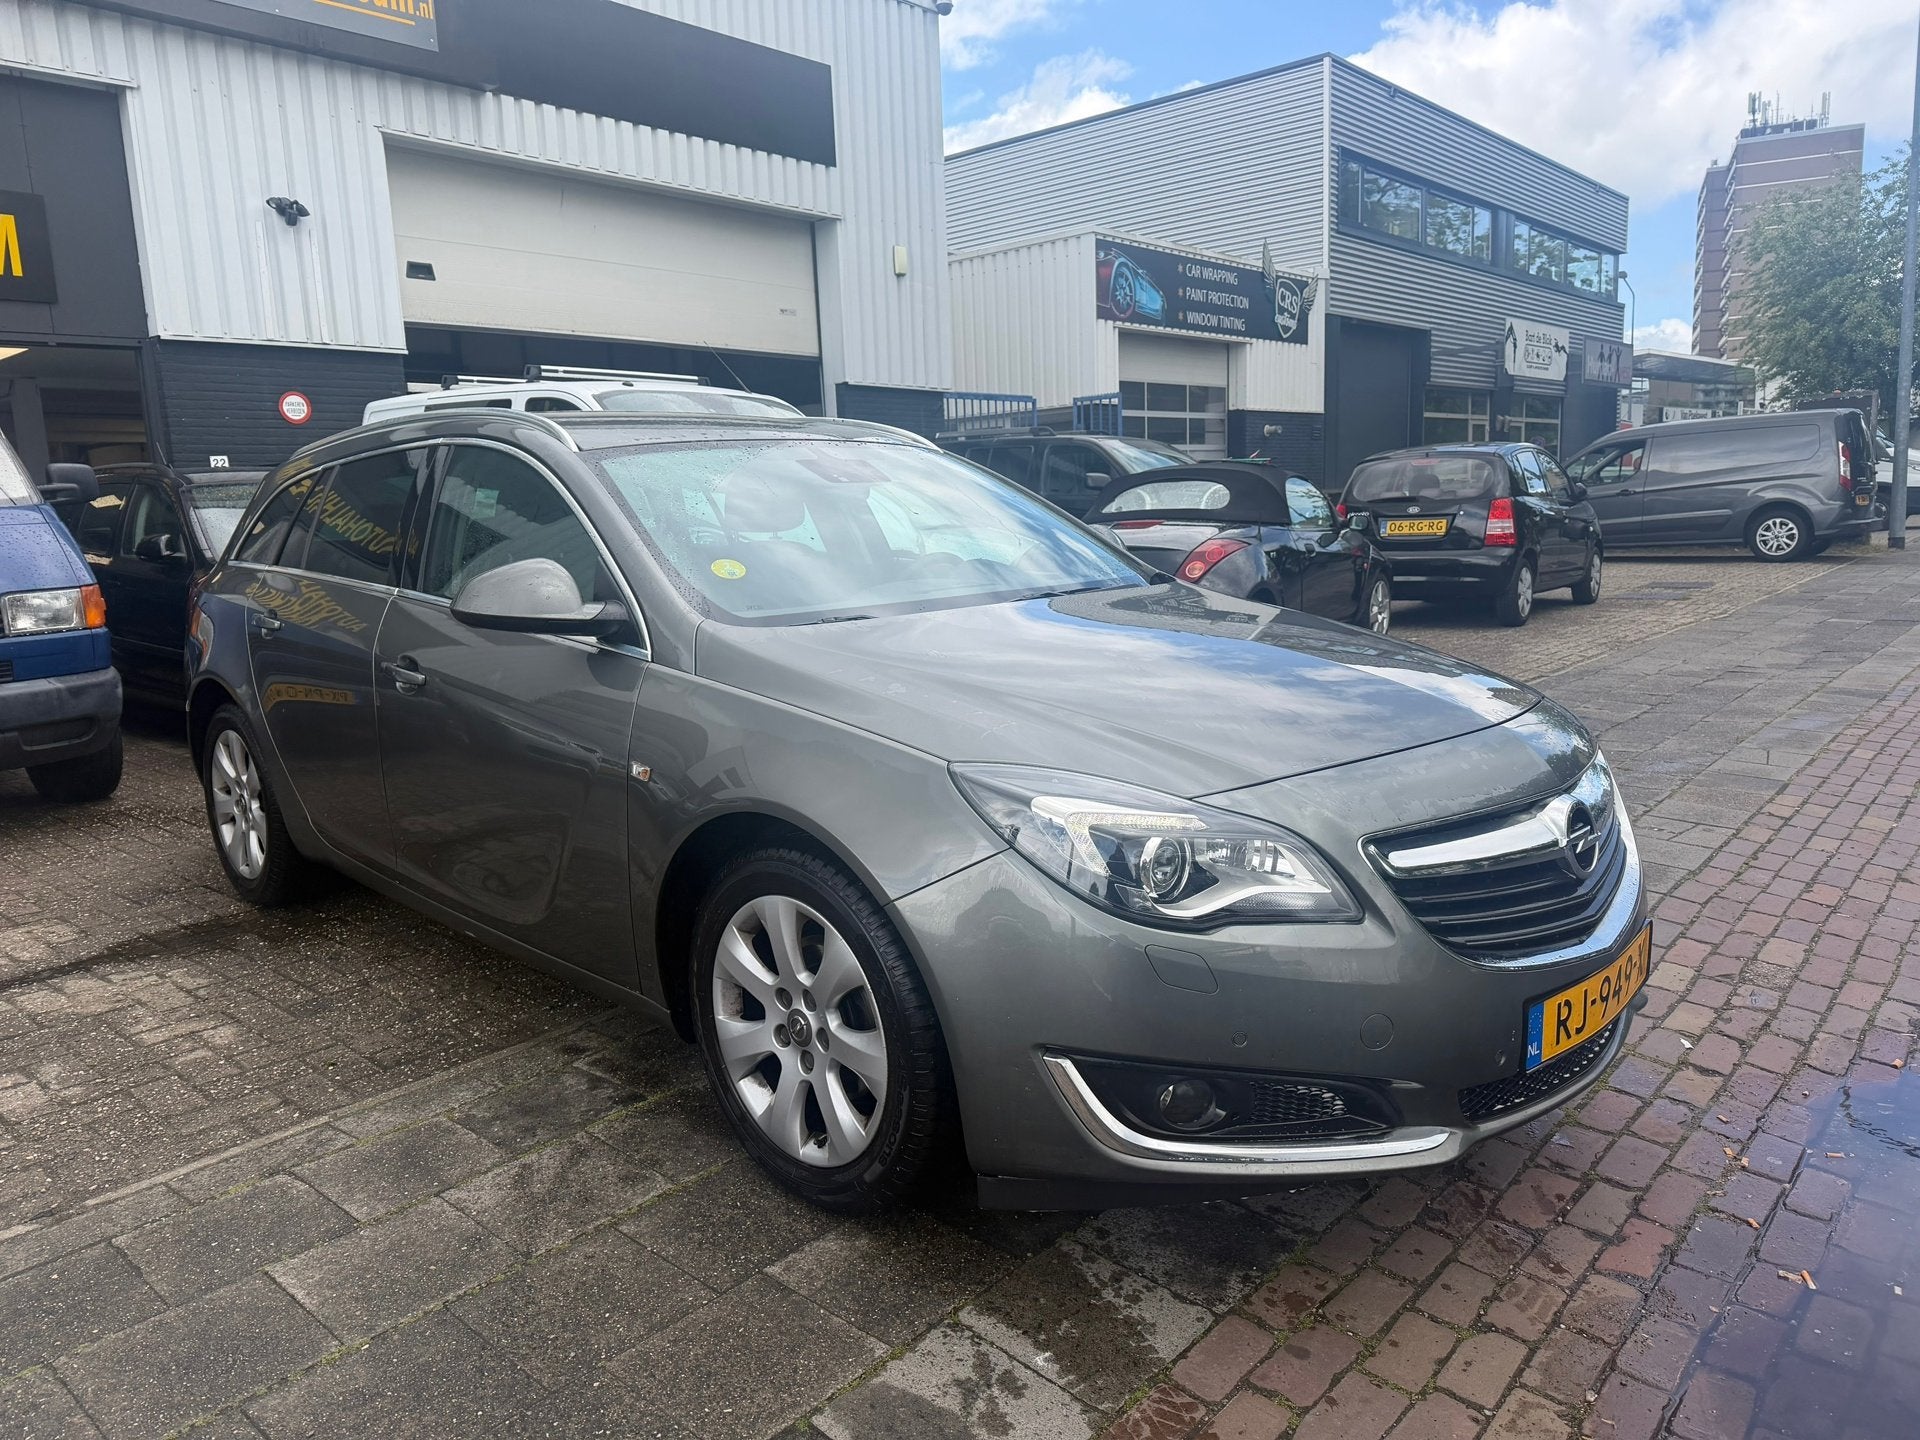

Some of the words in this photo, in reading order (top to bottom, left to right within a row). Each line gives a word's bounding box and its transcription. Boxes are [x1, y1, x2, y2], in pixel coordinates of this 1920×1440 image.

[1186, 263, 1201, 278] CAR
[1202, 266, 1238, 285] WRAPPING
[1186, 287, 1208, 302] PAINT
[1208, 290, 1249, 309] PROTECTION
[1279, 287, 1298, 313] CRS
[1186, 310, 1219, 327] WINDOW
[1219, 315, 1246, 331] TINTING
[213, 458, 227, 468] 22
[1389, 520, 1444, 532] 06-RG-RG
[1528, 1041, 1540, 1058] NL
